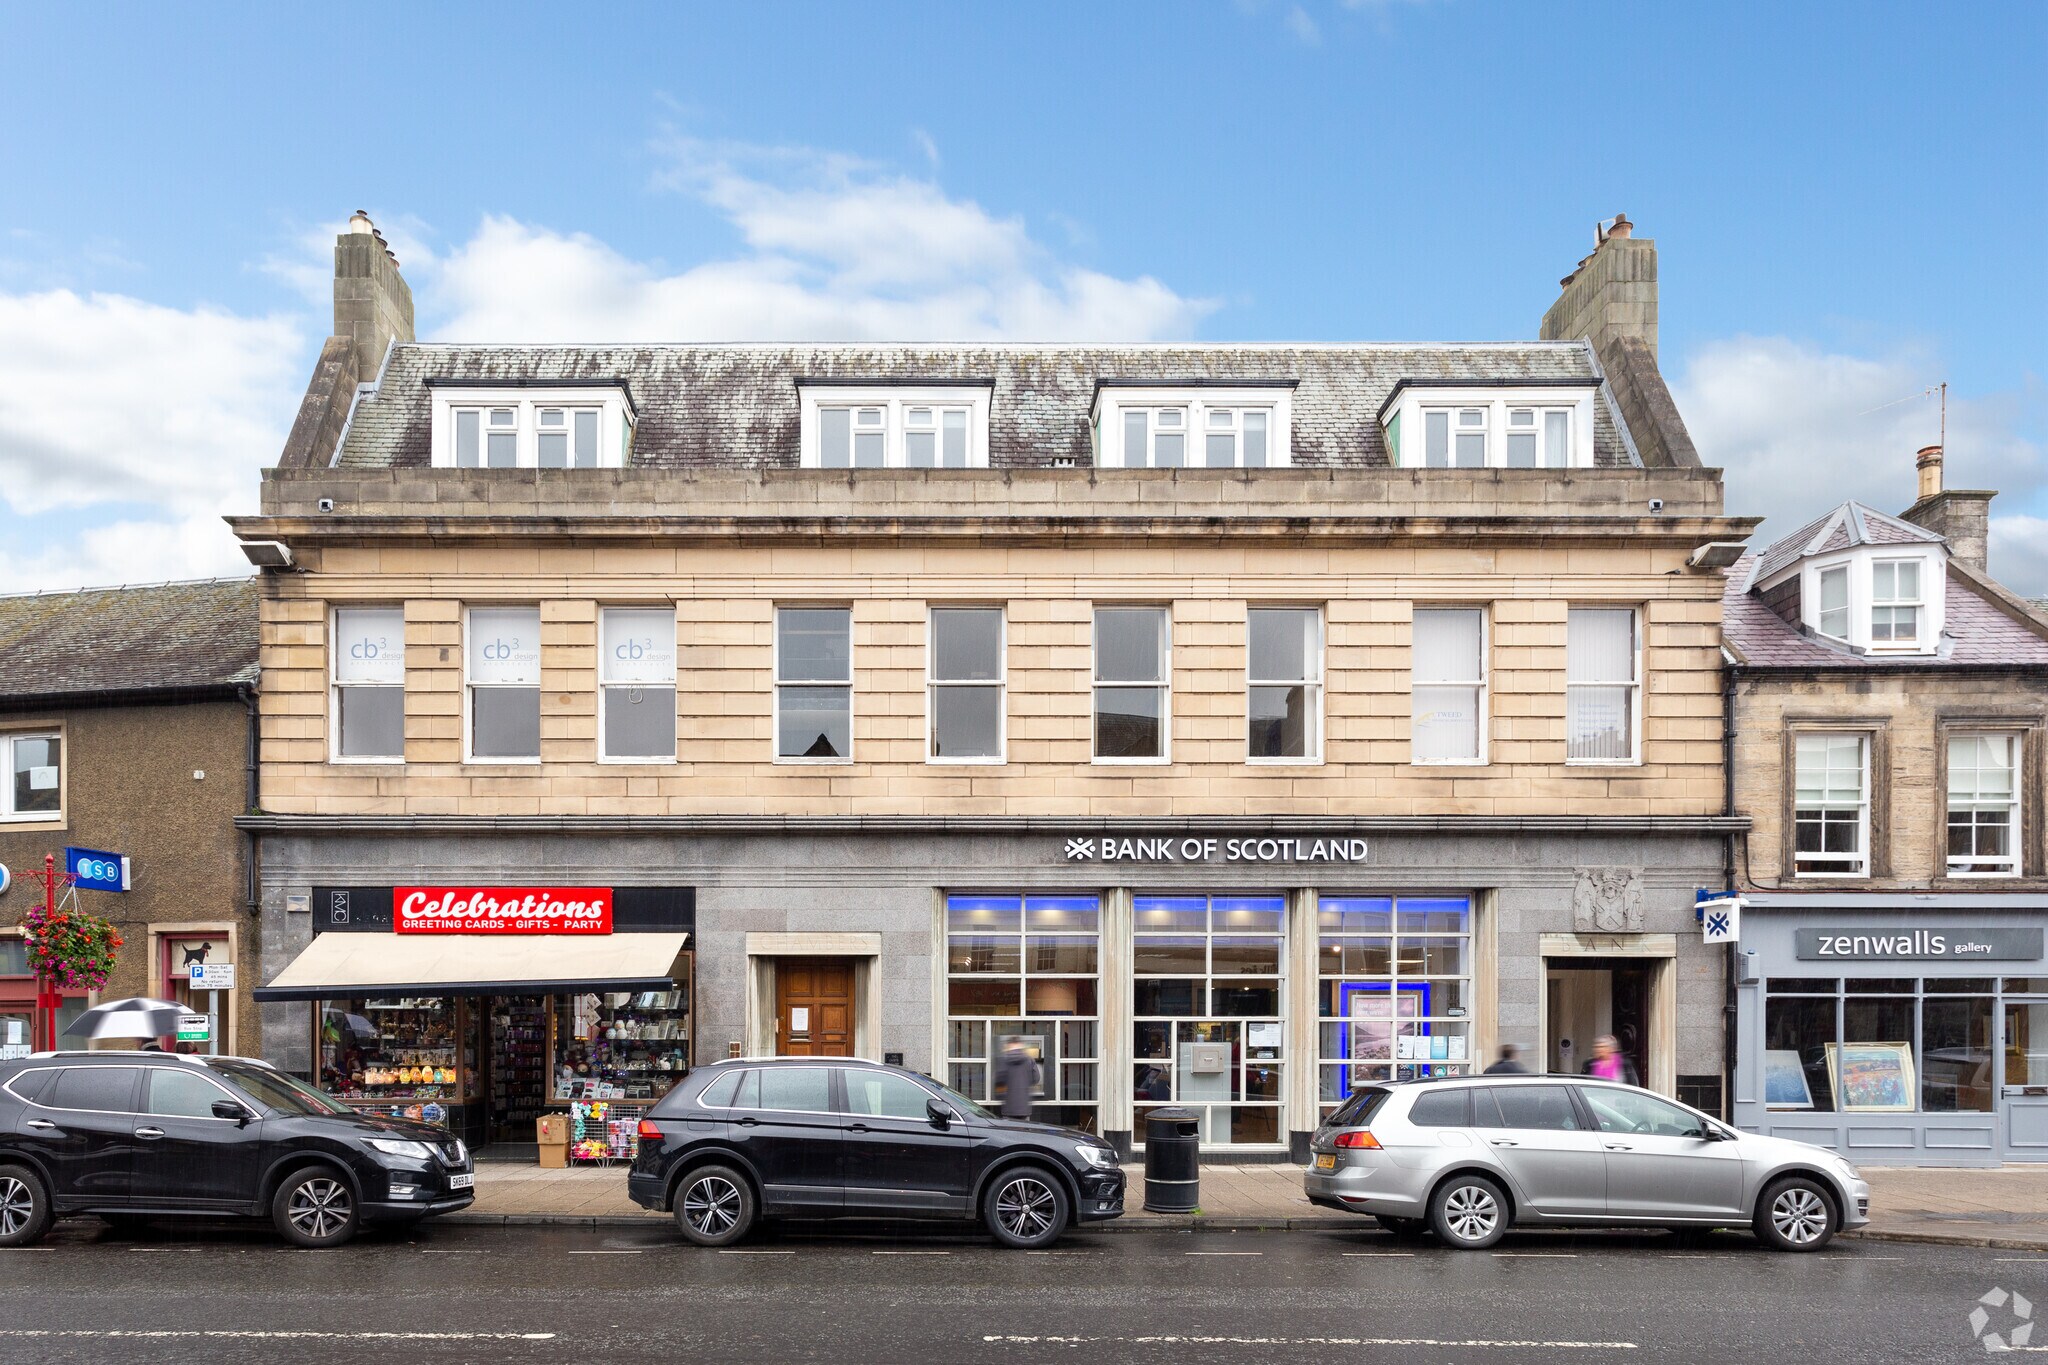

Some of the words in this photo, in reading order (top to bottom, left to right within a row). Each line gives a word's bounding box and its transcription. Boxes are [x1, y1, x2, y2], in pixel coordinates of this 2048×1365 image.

[514, 652, 538, 661] design
[646, 653, 671, 661] design
[1101, 838, 1174, 860] BANK
[1180, 838, 1217, 861] OF
[1226, 838, 1368, 861] SCOTLAND
[82, 863, 115, 878] TSB
[401, 891, 604, 919] Celebrations
[402, 919, 462, 929] GREETING
[465, 919, 505, 929] CARDS
[515, 919, 551, 929] GIFTS
[564, 919, 603, 929] PARTY
[760, 935, 869, 951] CHAMBERS
[1561, 937, 1651, 952] BANK
[1818, 930, 1946, 955] zenwalls
[1954, 942, 1992, 954] gallery
